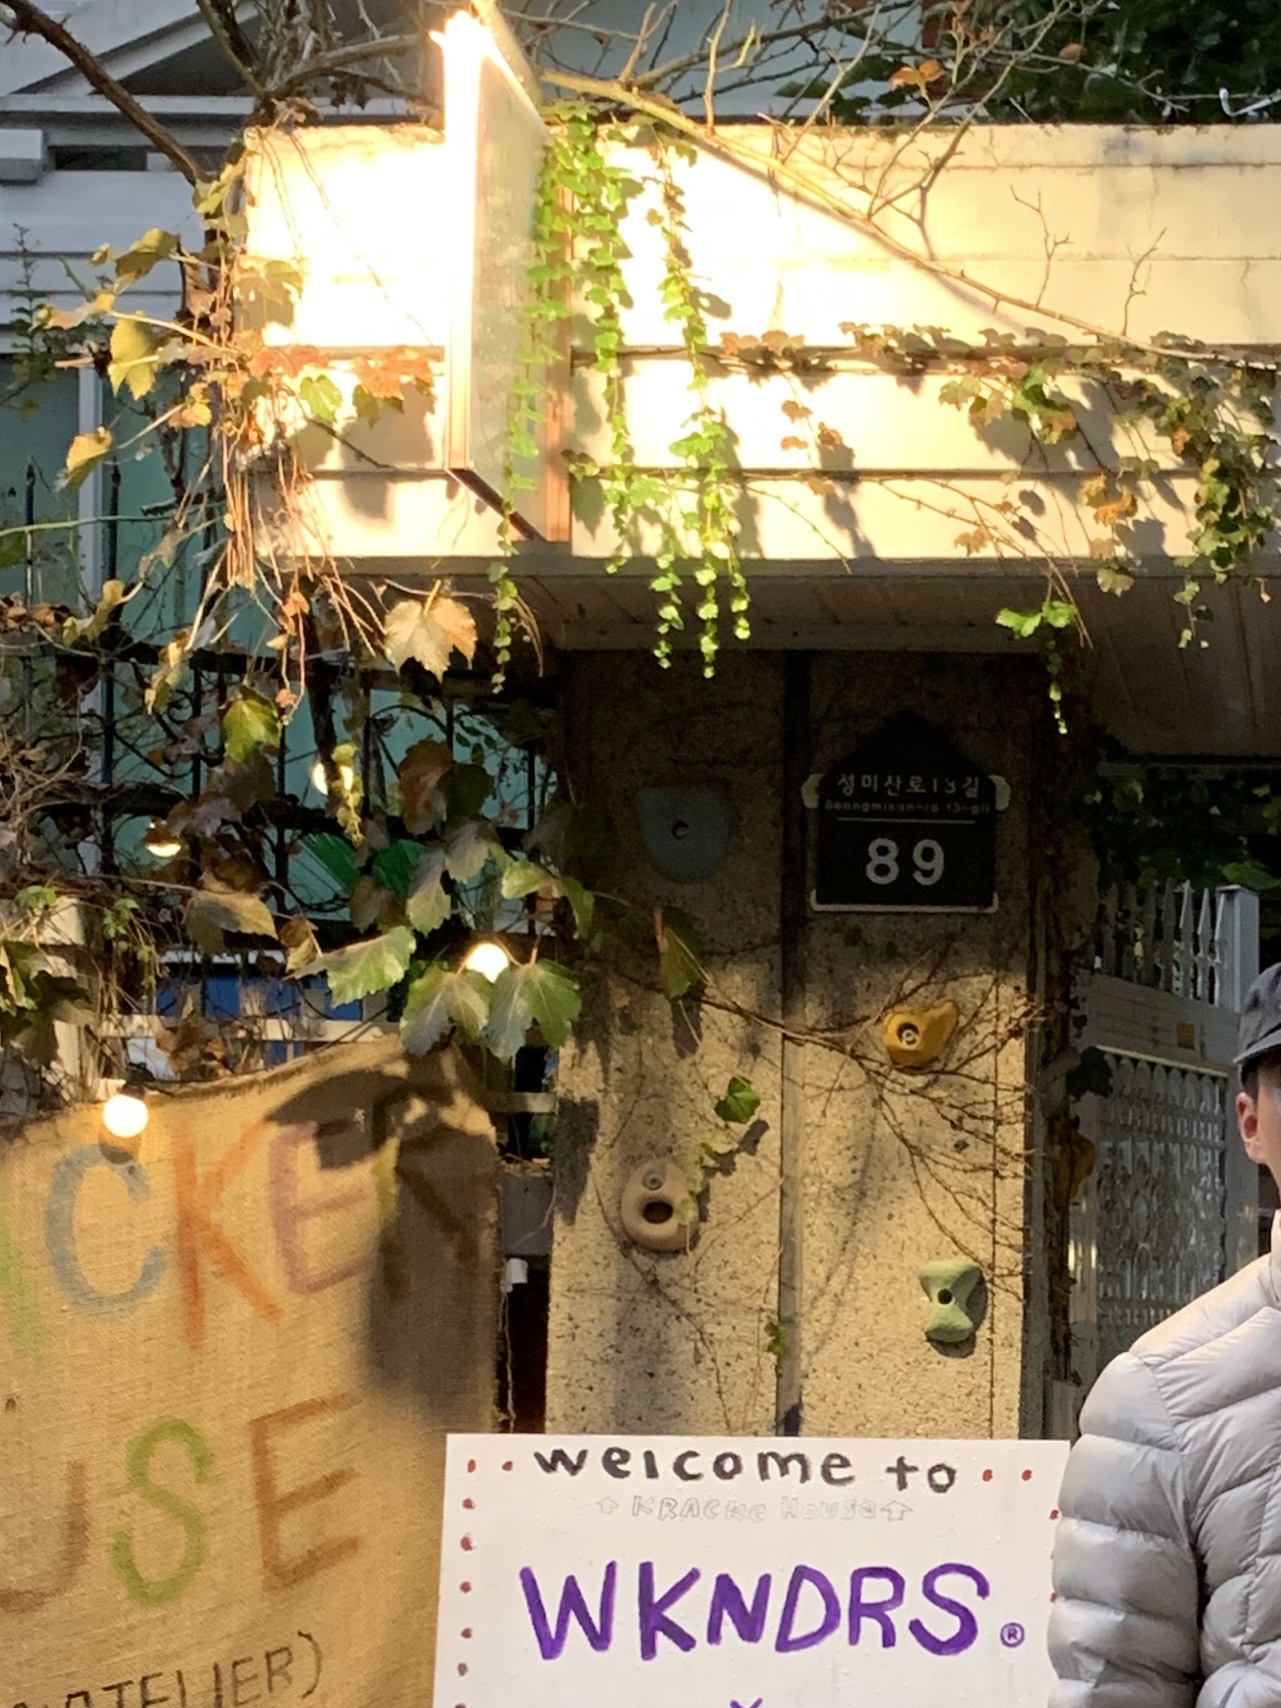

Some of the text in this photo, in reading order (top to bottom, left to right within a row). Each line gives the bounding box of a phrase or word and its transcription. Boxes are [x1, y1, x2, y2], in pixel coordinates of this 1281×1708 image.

[865, 837, 945, 886] 89
[534, 1446, 956, 1493] welcome to
[519, 1560, 990, 1661] WKNDRS
